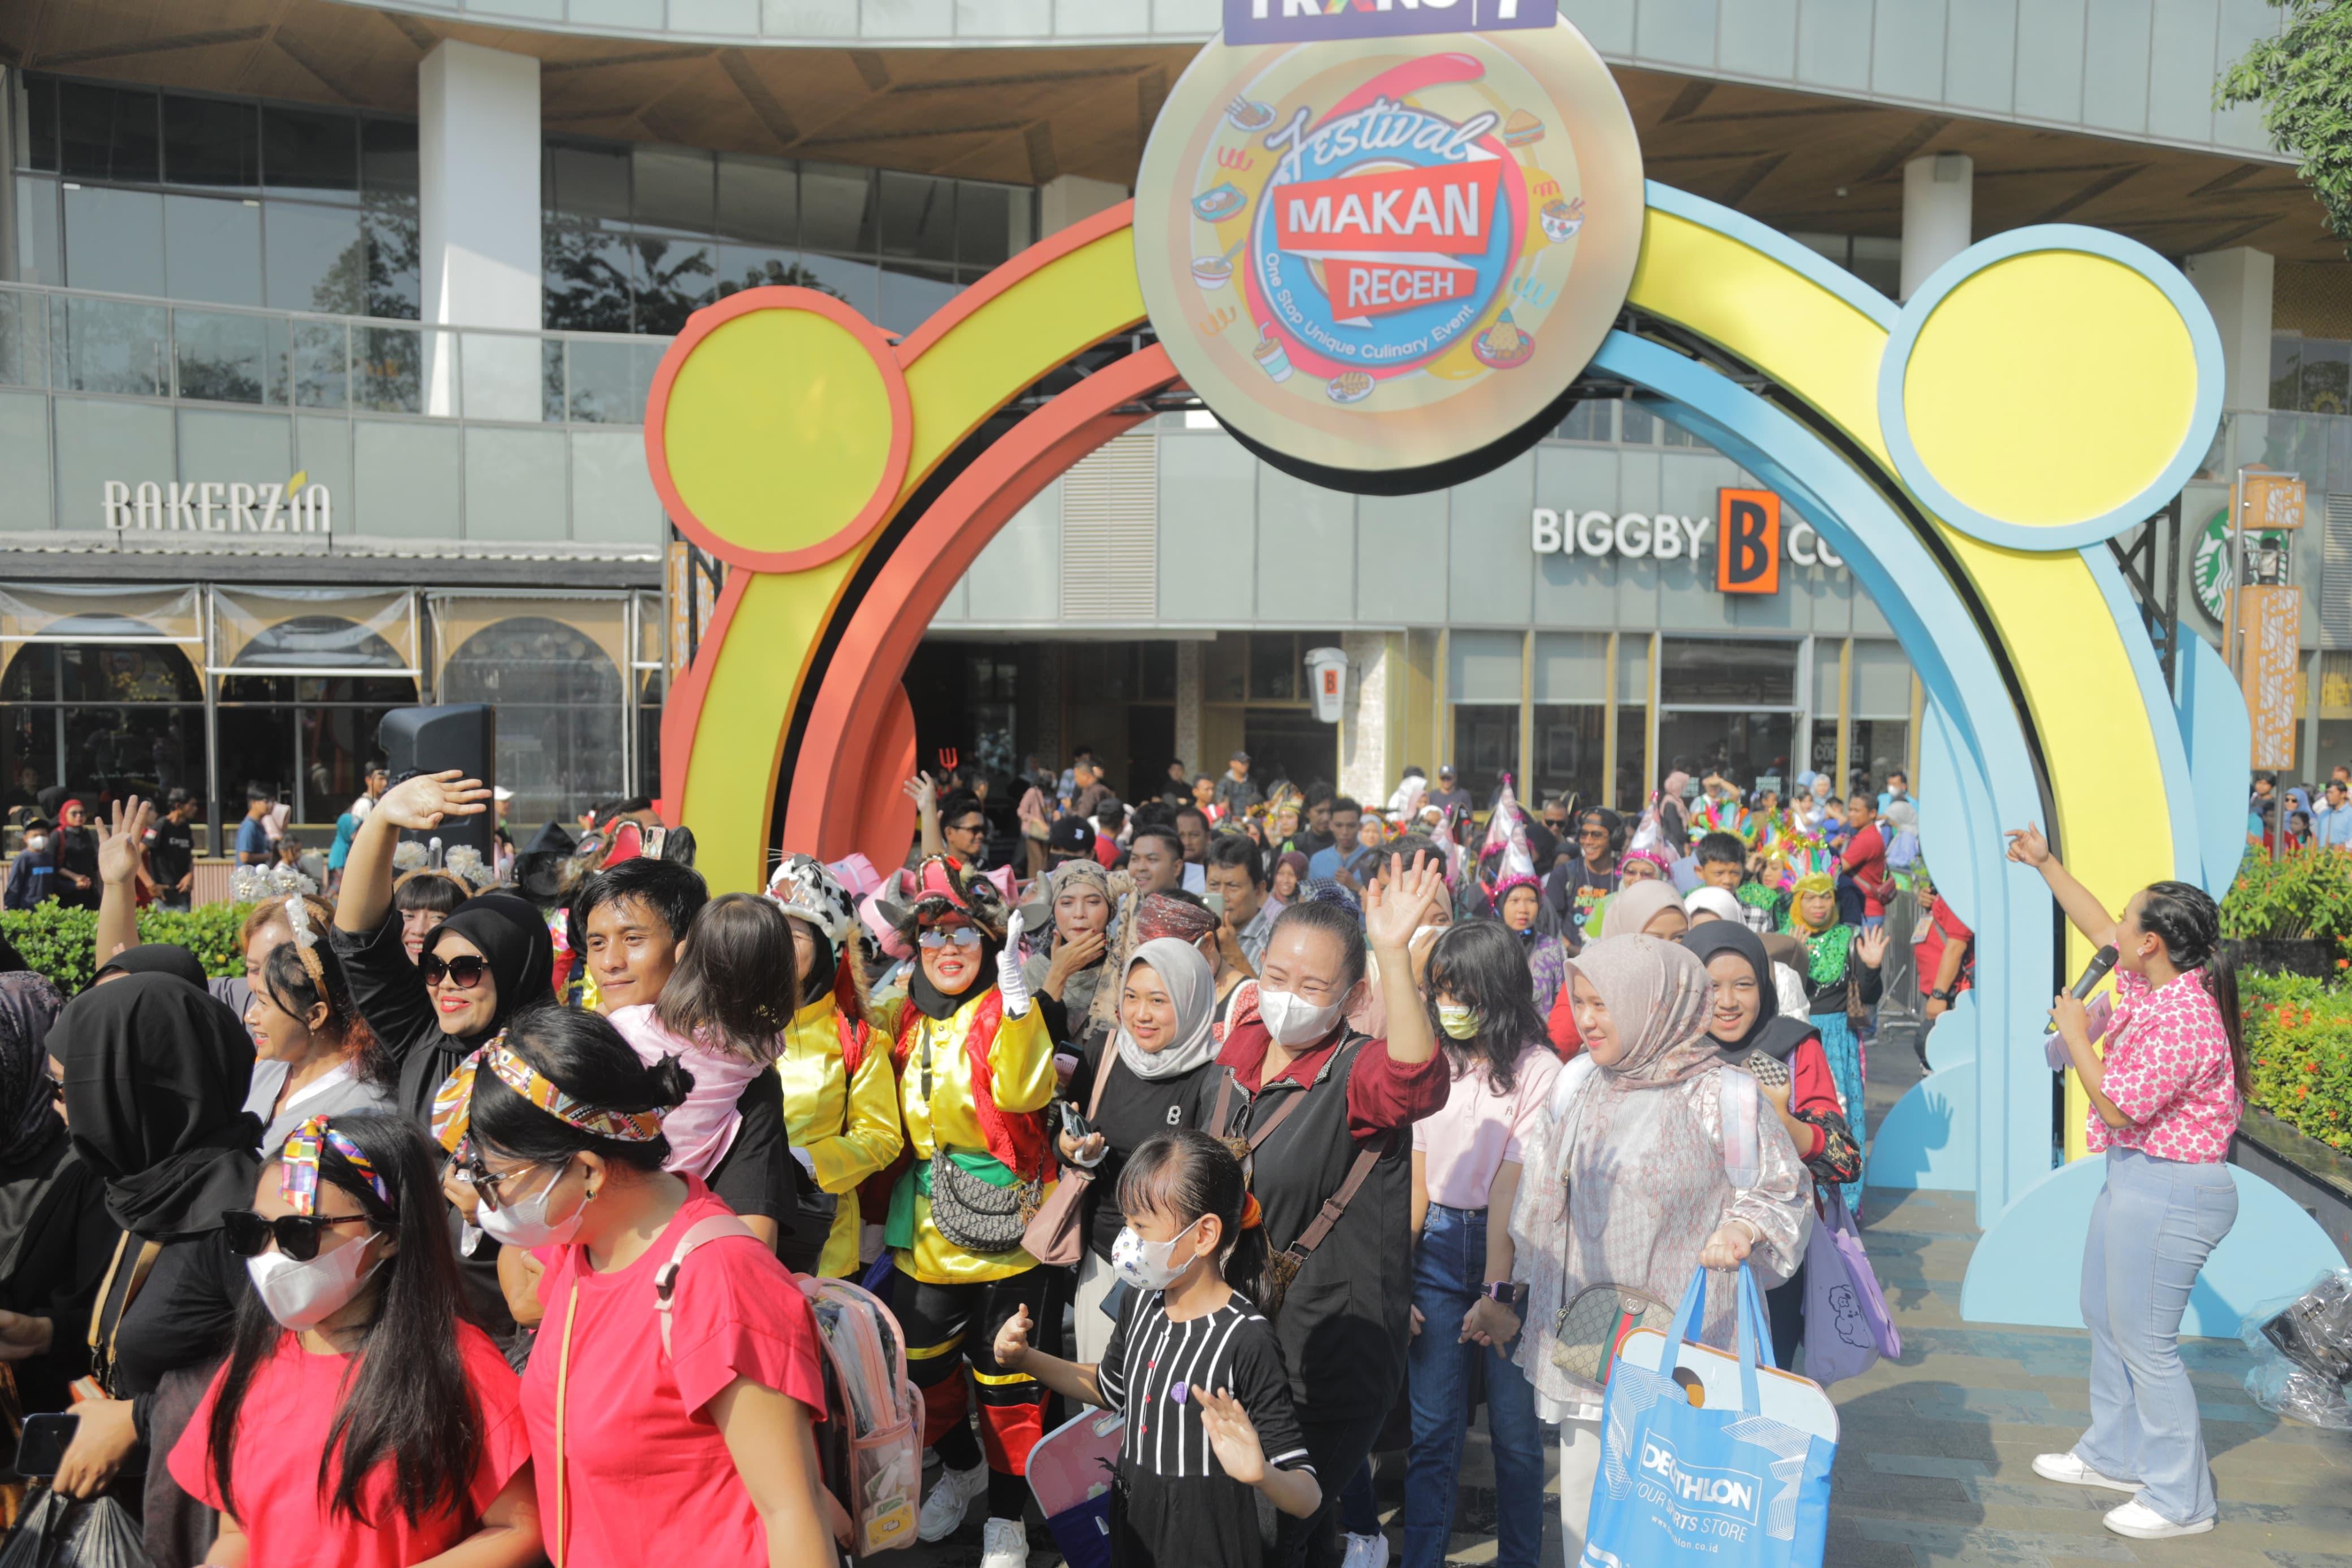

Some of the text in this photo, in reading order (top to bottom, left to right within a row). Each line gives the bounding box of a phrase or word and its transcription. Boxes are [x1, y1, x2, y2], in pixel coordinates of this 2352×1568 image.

[1265, 97, 1496, 181] Festival
[1289, 182, 1479, 236] MAKAN
[1265, 252, 1474, 359] One Stop Unique Culinary Event
[1349, 268, 1454, 307] RECEH
[1532, 508, 1709, 560] BIGGBY
[1728, 499, 1769, 584] B
[1642, 1442, 1752, 1511] DECTHLON
[1700, 1518, 1748, 1543] STORE
